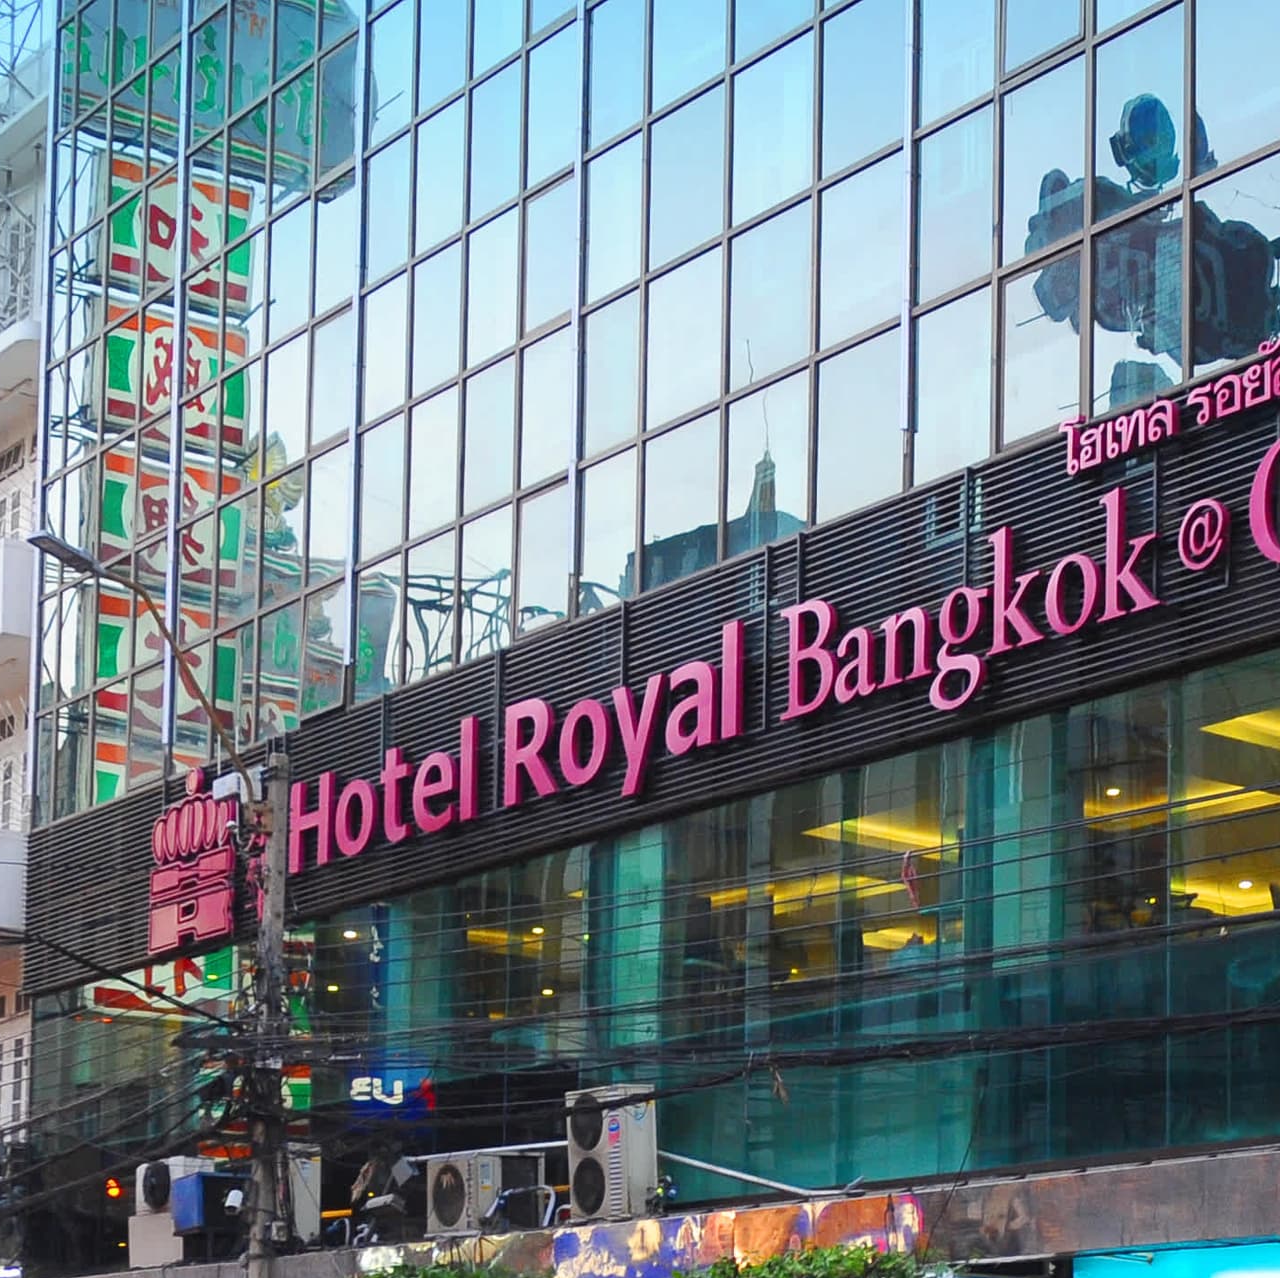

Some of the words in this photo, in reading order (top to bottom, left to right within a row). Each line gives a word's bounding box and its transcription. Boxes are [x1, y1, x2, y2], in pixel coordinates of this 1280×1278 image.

[1060, 391, 1180, 476] โฮเทล
[289, 715, 480, 873] Hotel
[502, 620, 746, 806] Royal
[780, 486, 1161, 722] Bangkok
[1178, 497, 1230, 571] @
